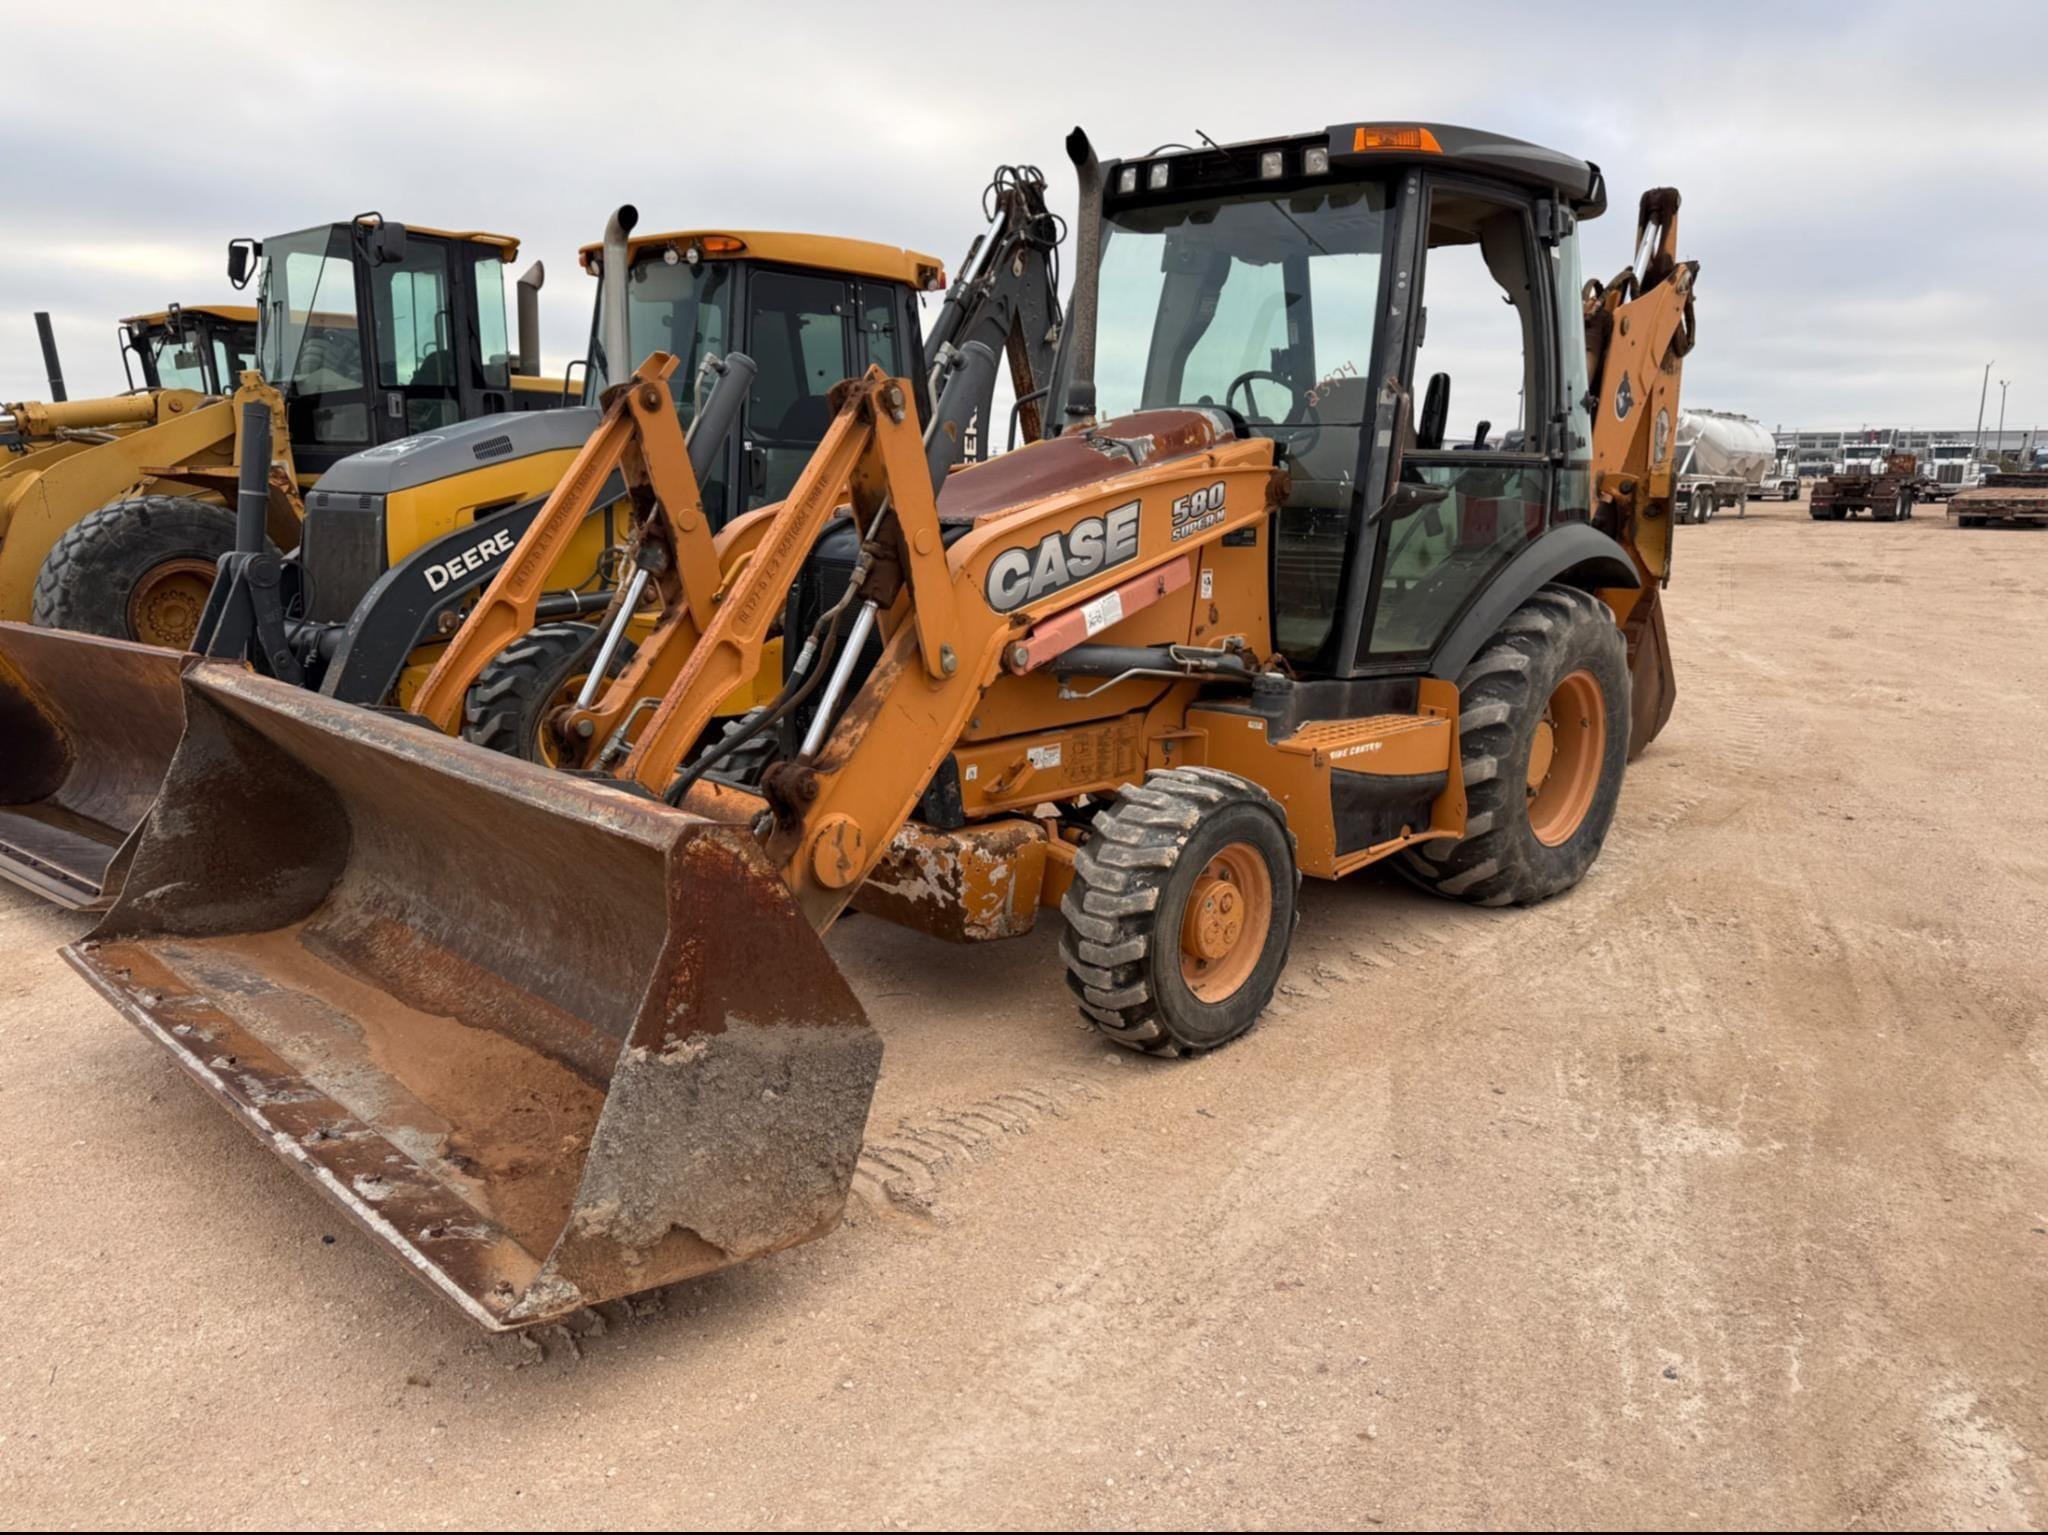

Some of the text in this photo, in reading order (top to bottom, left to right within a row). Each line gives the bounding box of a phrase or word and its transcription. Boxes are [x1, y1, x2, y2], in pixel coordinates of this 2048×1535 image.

[1172, 481, 1226, 526] 580
[1172, 513, 1215, 541] SUPER
[423, 528, 515, 592] DEERE
[985, 500, 1141, 613] CASE
